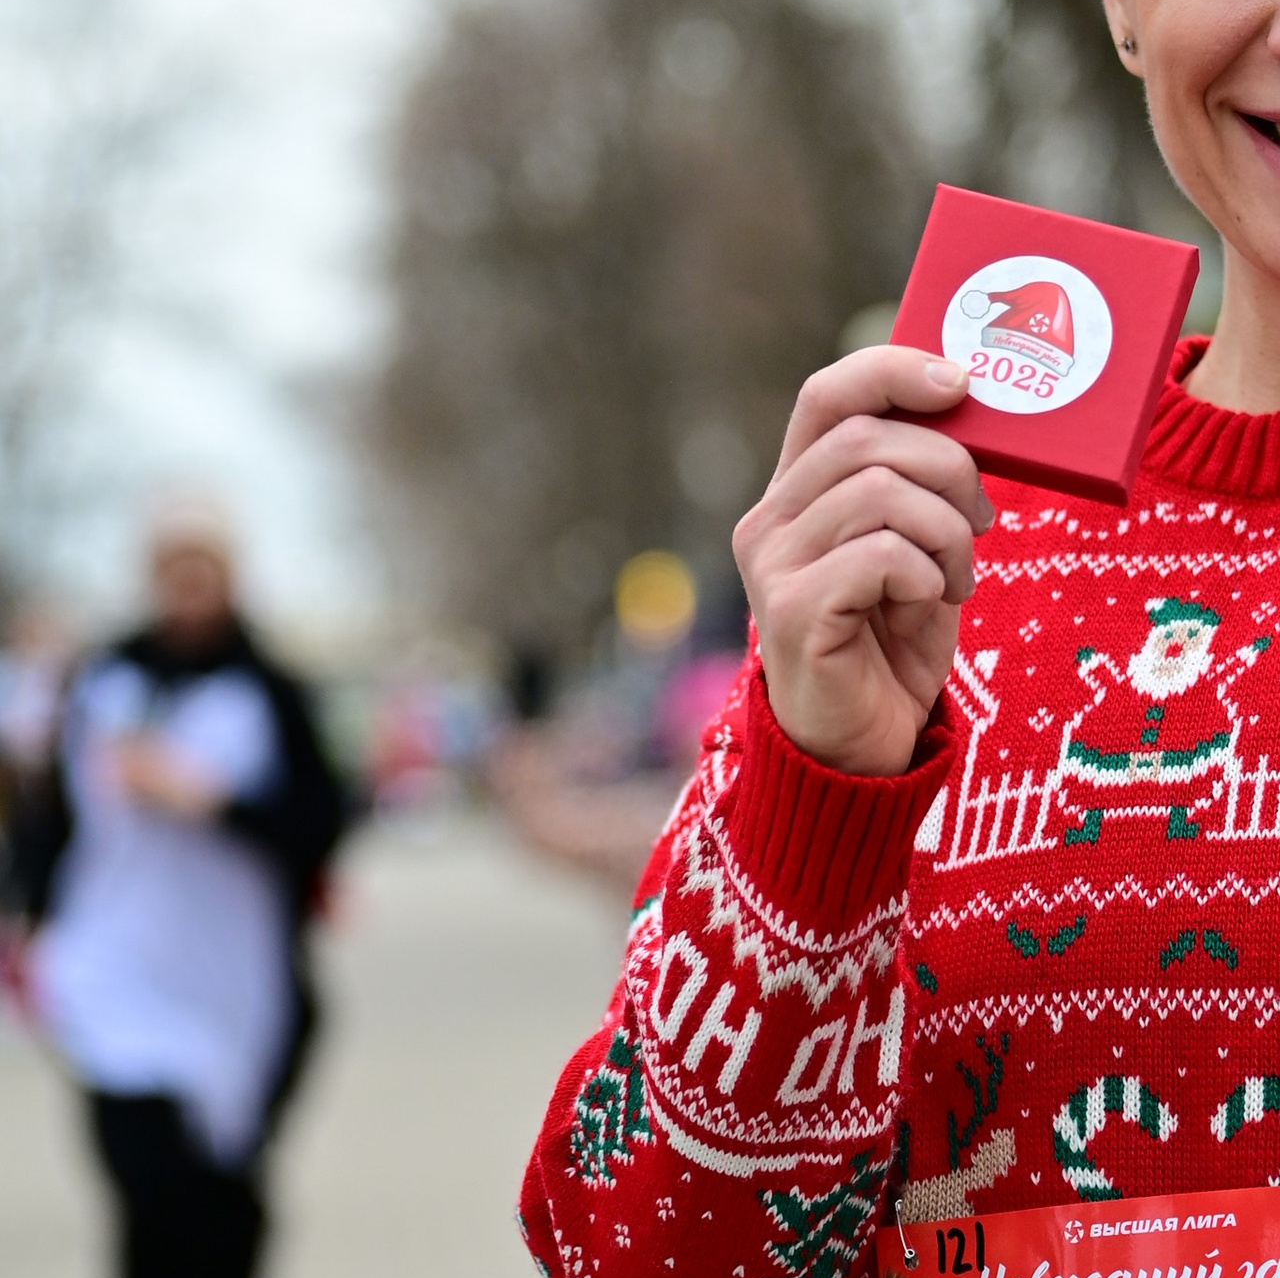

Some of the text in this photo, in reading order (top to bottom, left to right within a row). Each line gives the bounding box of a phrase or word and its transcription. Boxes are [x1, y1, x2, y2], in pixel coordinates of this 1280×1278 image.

[968, 352, 1060, 398] 2025
[936, 1221, 986, 1275] 121
[1089, 1213, 1238, 1238] ВЫСШАЯ ЛИГА
